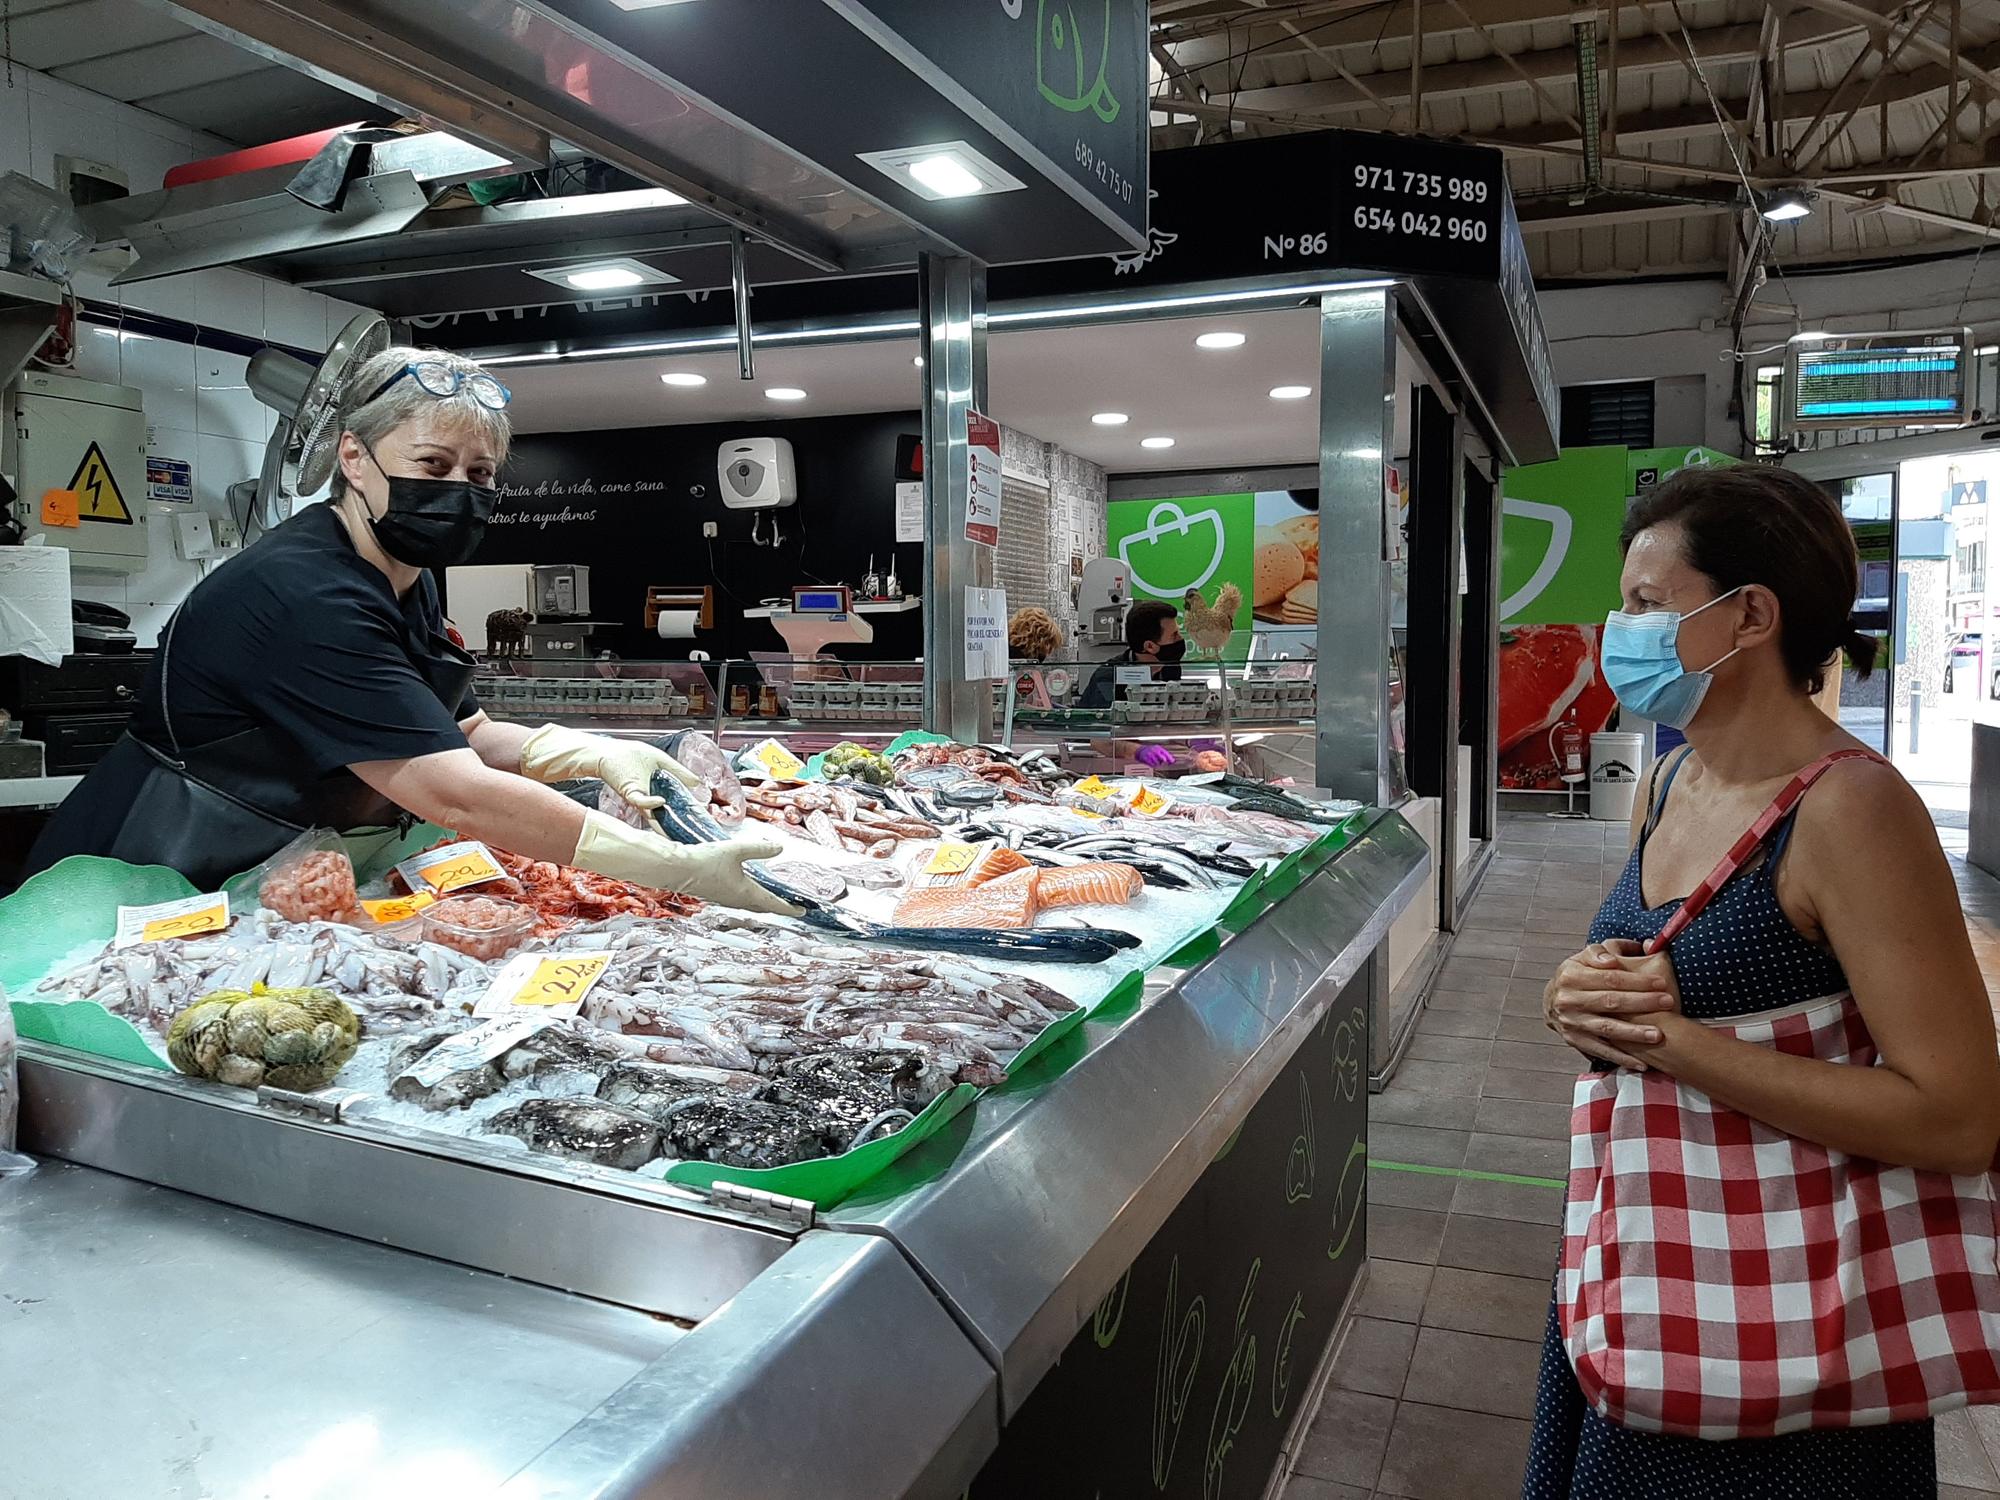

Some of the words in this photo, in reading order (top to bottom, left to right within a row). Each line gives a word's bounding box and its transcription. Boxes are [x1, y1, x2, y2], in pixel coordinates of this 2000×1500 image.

[1075, 138, 1093, 171] 689
[1095, 158, 1107, 184] 42
[1109, 167, 1120, 195] 75
[1122, 180, 1133, 205] 07
[1354, 164, 1396, 192] 971
[1402, 171, 1442, 198] 735
[1448, 177, 1488, 203] 989
[1354, 205, 1396, 232] 654
[1401, 211, 1442, 238] 042
[1448, 217, 1487, 243] 960
[1299, 232, 1328, 256] 86
[495, 482, 532, 504] sfruta
[534, 480, 549, 498] de
[551, 479, 565, 496] la
[567, 478, 597, 496] vida,
[600, 482, 632, 493] come
[487, 511, 518, 525] otros
[519, 510, 531, 523] te
[532, 505, 598, 530] ayudamos
[542, 963, 586, 995] 22
